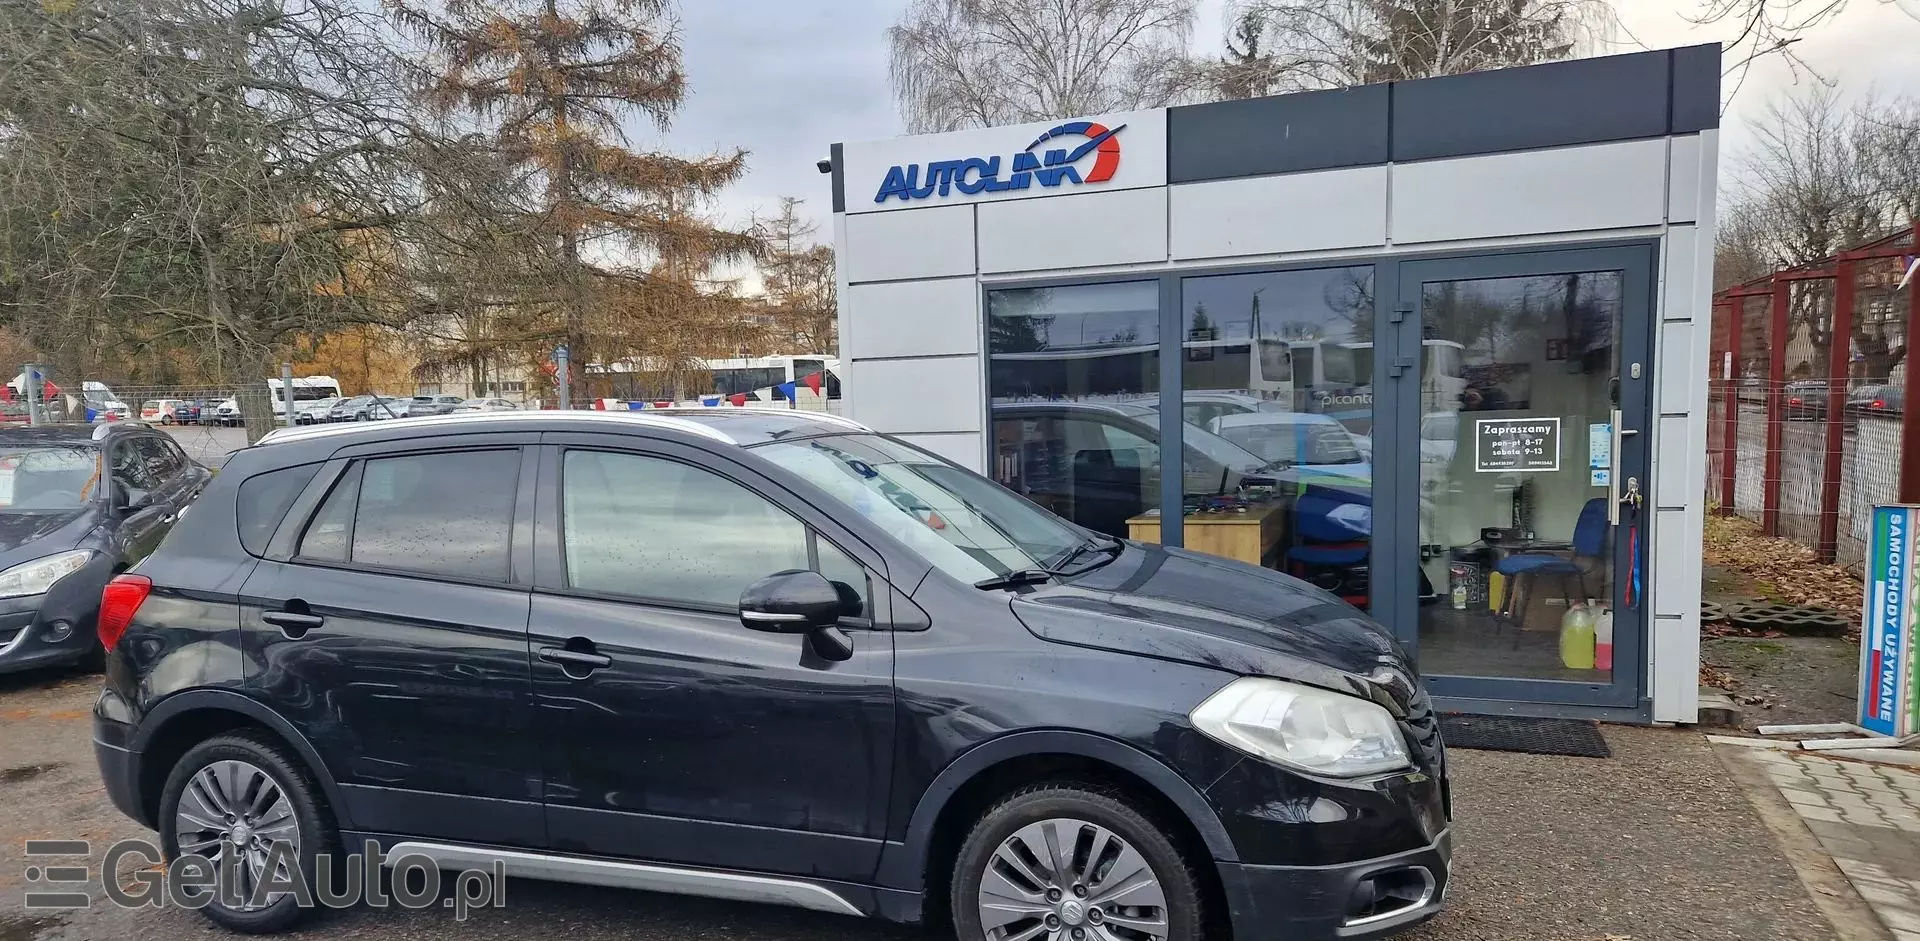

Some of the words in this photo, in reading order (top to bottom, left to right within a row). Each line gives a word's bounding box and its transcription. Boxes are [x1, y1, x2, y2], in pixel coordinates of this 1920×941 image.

[874, 147, 1084, 203] AUTOLINK
[1484, 425, 1551, 436] Zapraszamy
[1492, 439, 1521, 448] pon-pt
[1525, 438, 1543, 446] 8-17
[1525, 447, 1543, 455] 9-13
[1886, 514, 1902, 628] SAMOCHODY
[1880, 633, 1898, 722] UŻYWANE
